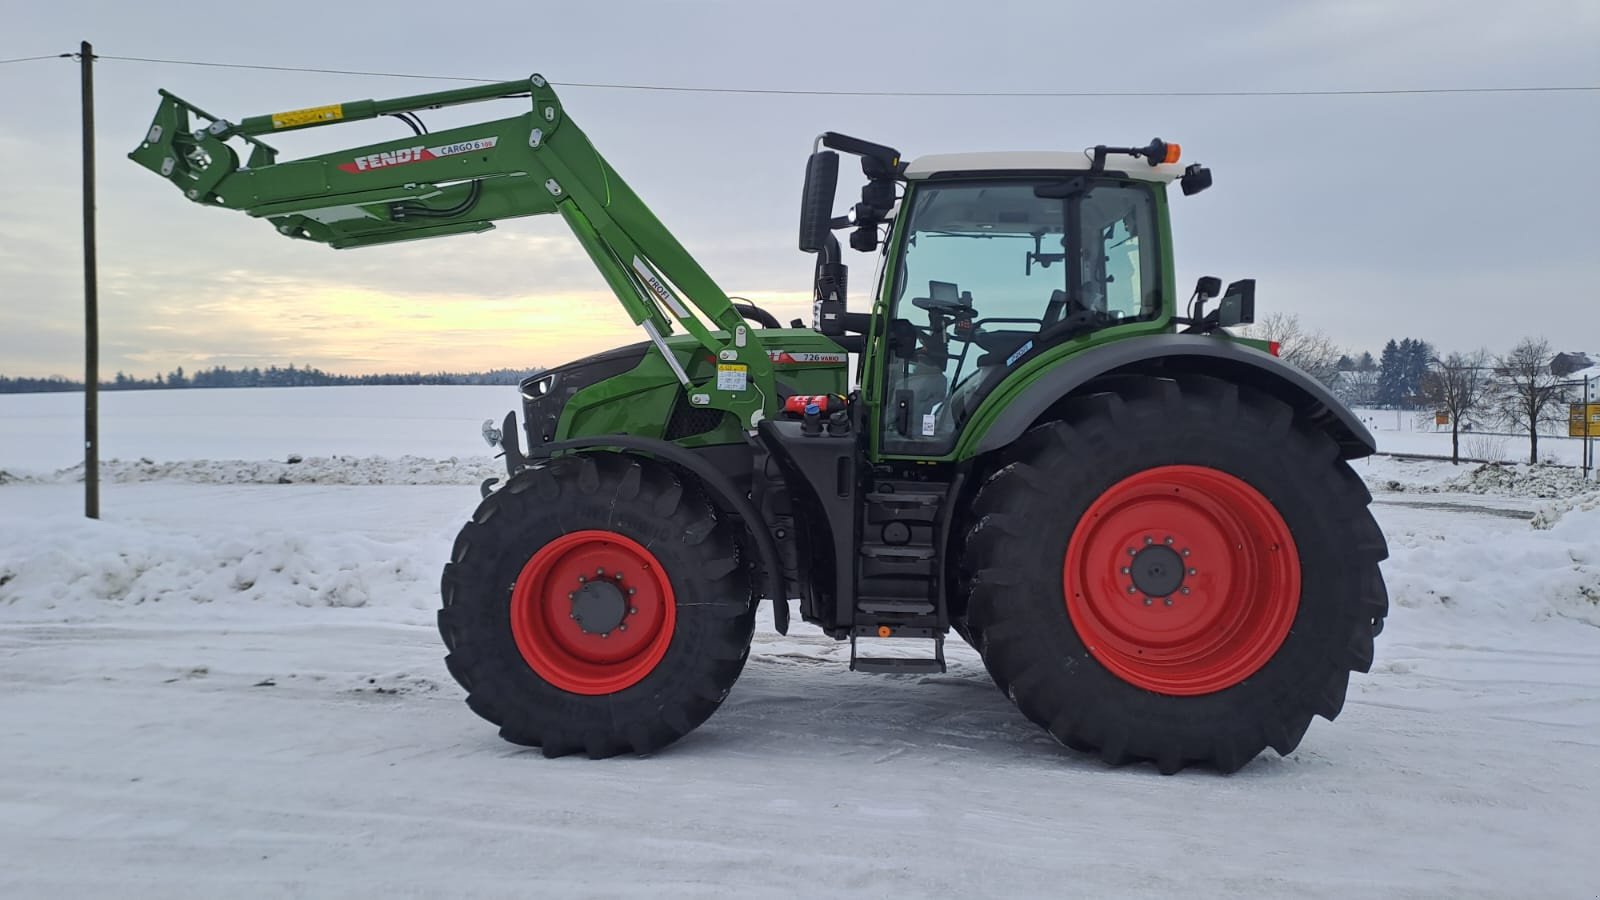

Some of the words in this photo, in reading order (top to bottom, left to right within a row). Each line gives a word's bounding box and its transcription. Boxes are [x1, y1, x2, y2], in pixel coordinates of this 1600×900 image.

[441, 143, 472, 155] CARGO
[354, 146, 425, 171] FENDT
[649, 277, 670, 300] PROFI
[803, 353, 820, 361] 726
